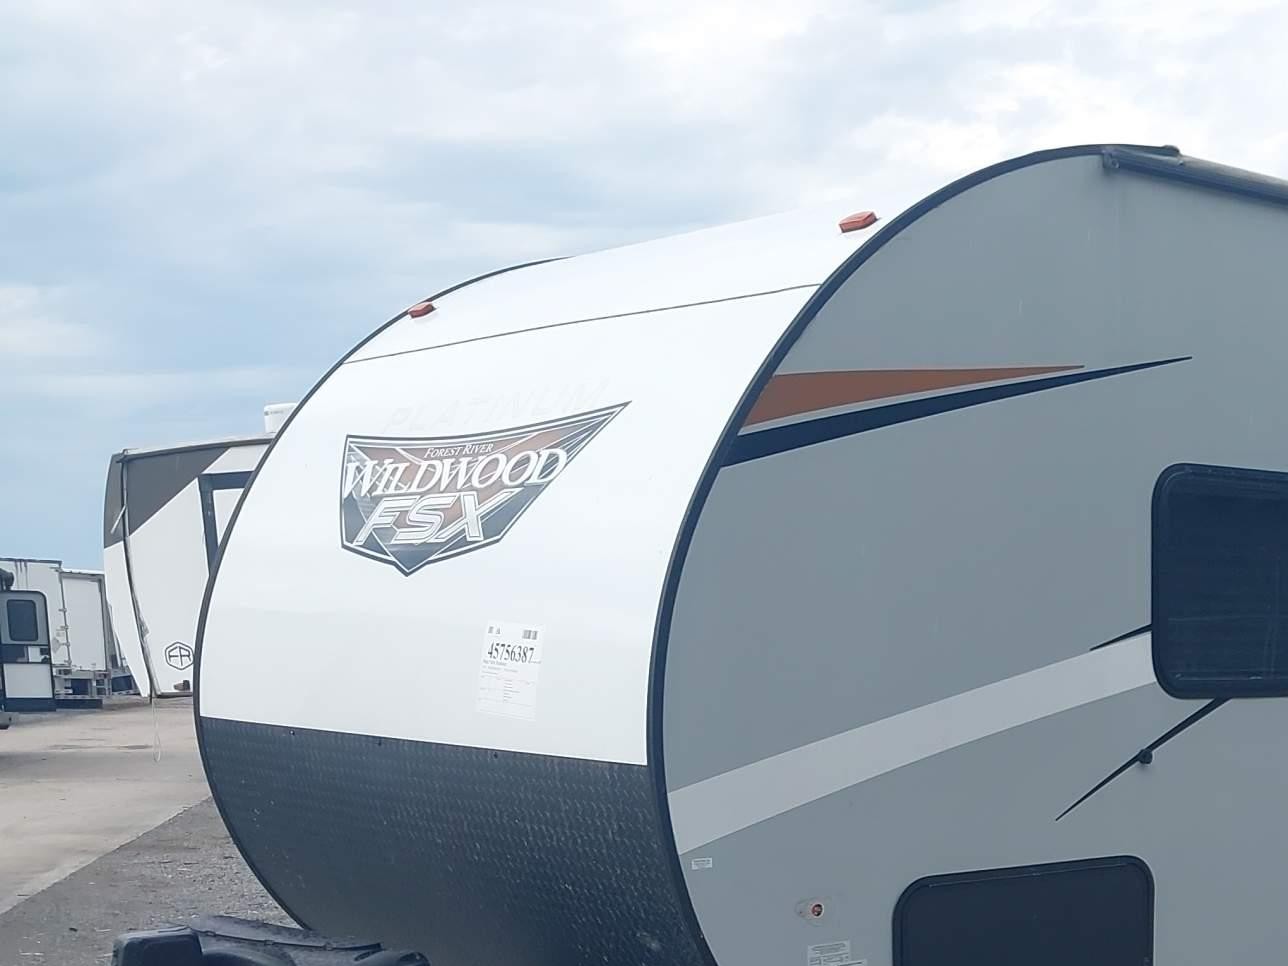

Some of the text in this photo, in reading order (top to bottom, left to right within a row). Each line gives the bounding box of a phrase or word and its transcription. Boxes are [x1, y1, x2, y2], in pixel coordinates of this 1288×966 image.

[424, 443, 494, 459] FOREST RIVER
[344, 449, 569, 499] WILDWOOD
[353, 489, 525, 545] FSX
[488, 639, 535, 664] 45756387
